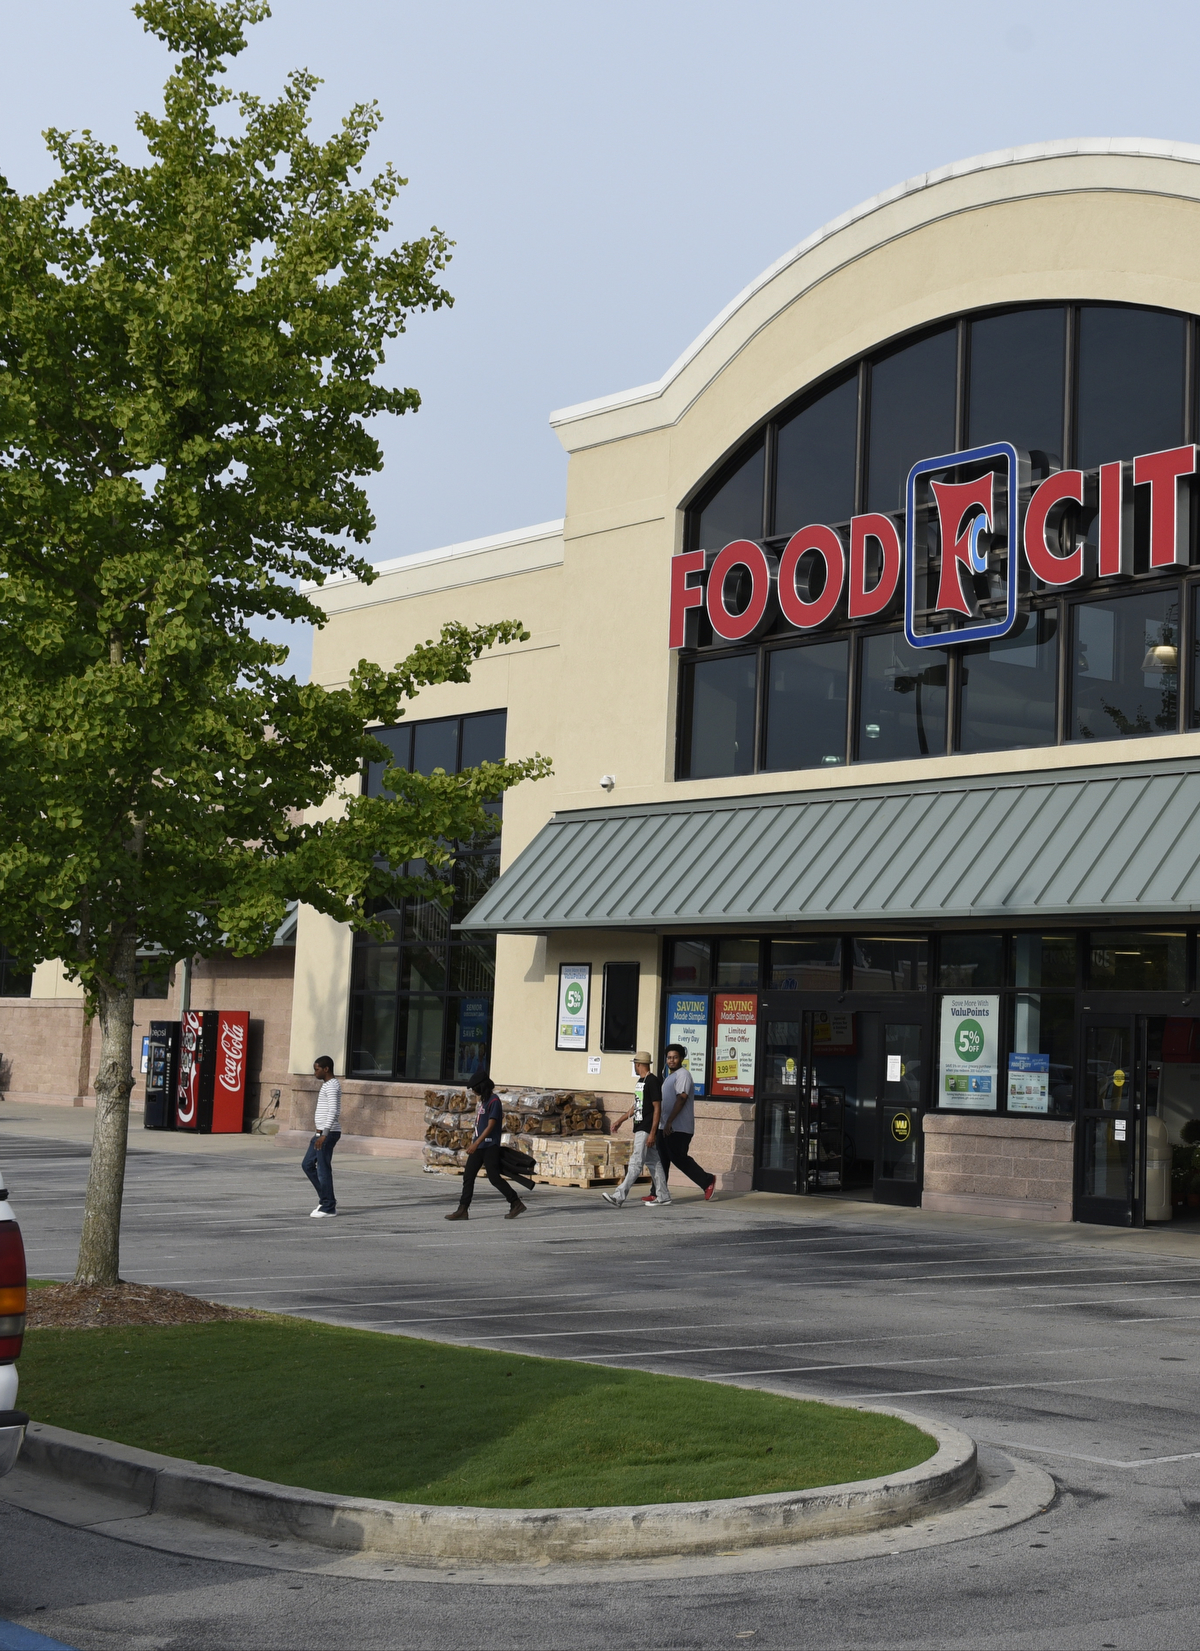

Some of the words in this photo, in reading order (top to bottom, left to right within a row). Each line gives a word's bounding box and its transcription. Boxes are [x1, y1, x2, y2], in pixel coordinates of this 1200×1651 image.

[668, 512, 903, 650] FOOD
[567, 990, 581, 1008] 5%
[676, 1001, 705, 1012] SAVING
[723, 1000, 753, 1012] SAVING
[674, 1012, 688, 1020] Made
[720, 1012, 736, 1020] Made
[951, 1008, 989, 1017] ValuPoints
[463, 1030, 475, 1038] SAVE
[728, 1027, 746, 1035] Limited
[678, 1035, 690, 1043] Every
[958, 1030, 980, 1052] 5%
[717, 1065, 728, 1074] 3.99
[895, 1120, 907, 1129] WU
